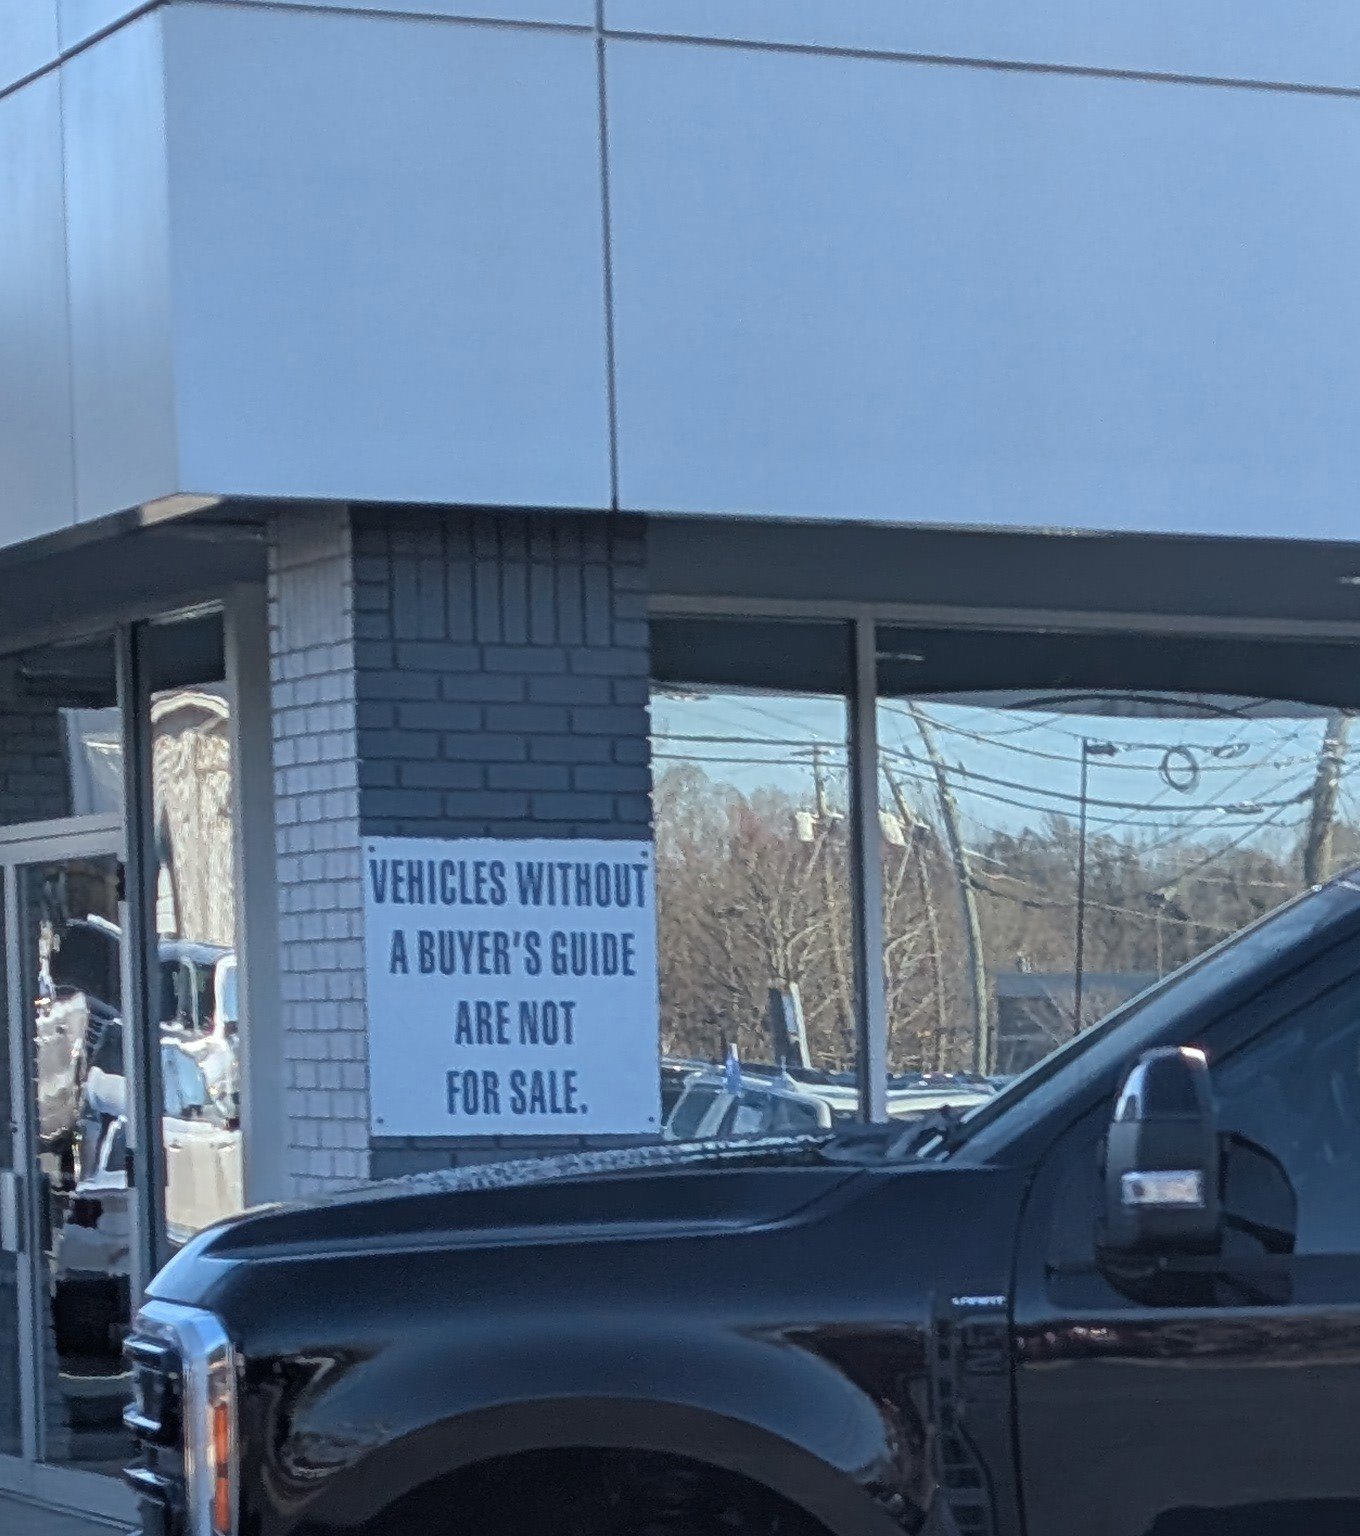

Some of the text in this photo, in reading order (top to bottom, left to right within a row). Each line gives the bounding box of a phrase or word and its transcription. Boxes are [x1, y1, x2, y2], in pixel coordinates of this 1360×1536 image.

[368, 859, 649, 908] VEHICLES WITHOUT
[389, 929, 636, 977] A BUYER'S GUIDE
[454, 1000, 577, 1046] ARE NOT
[446, 1069, 589, 1116] FOR SALE.
